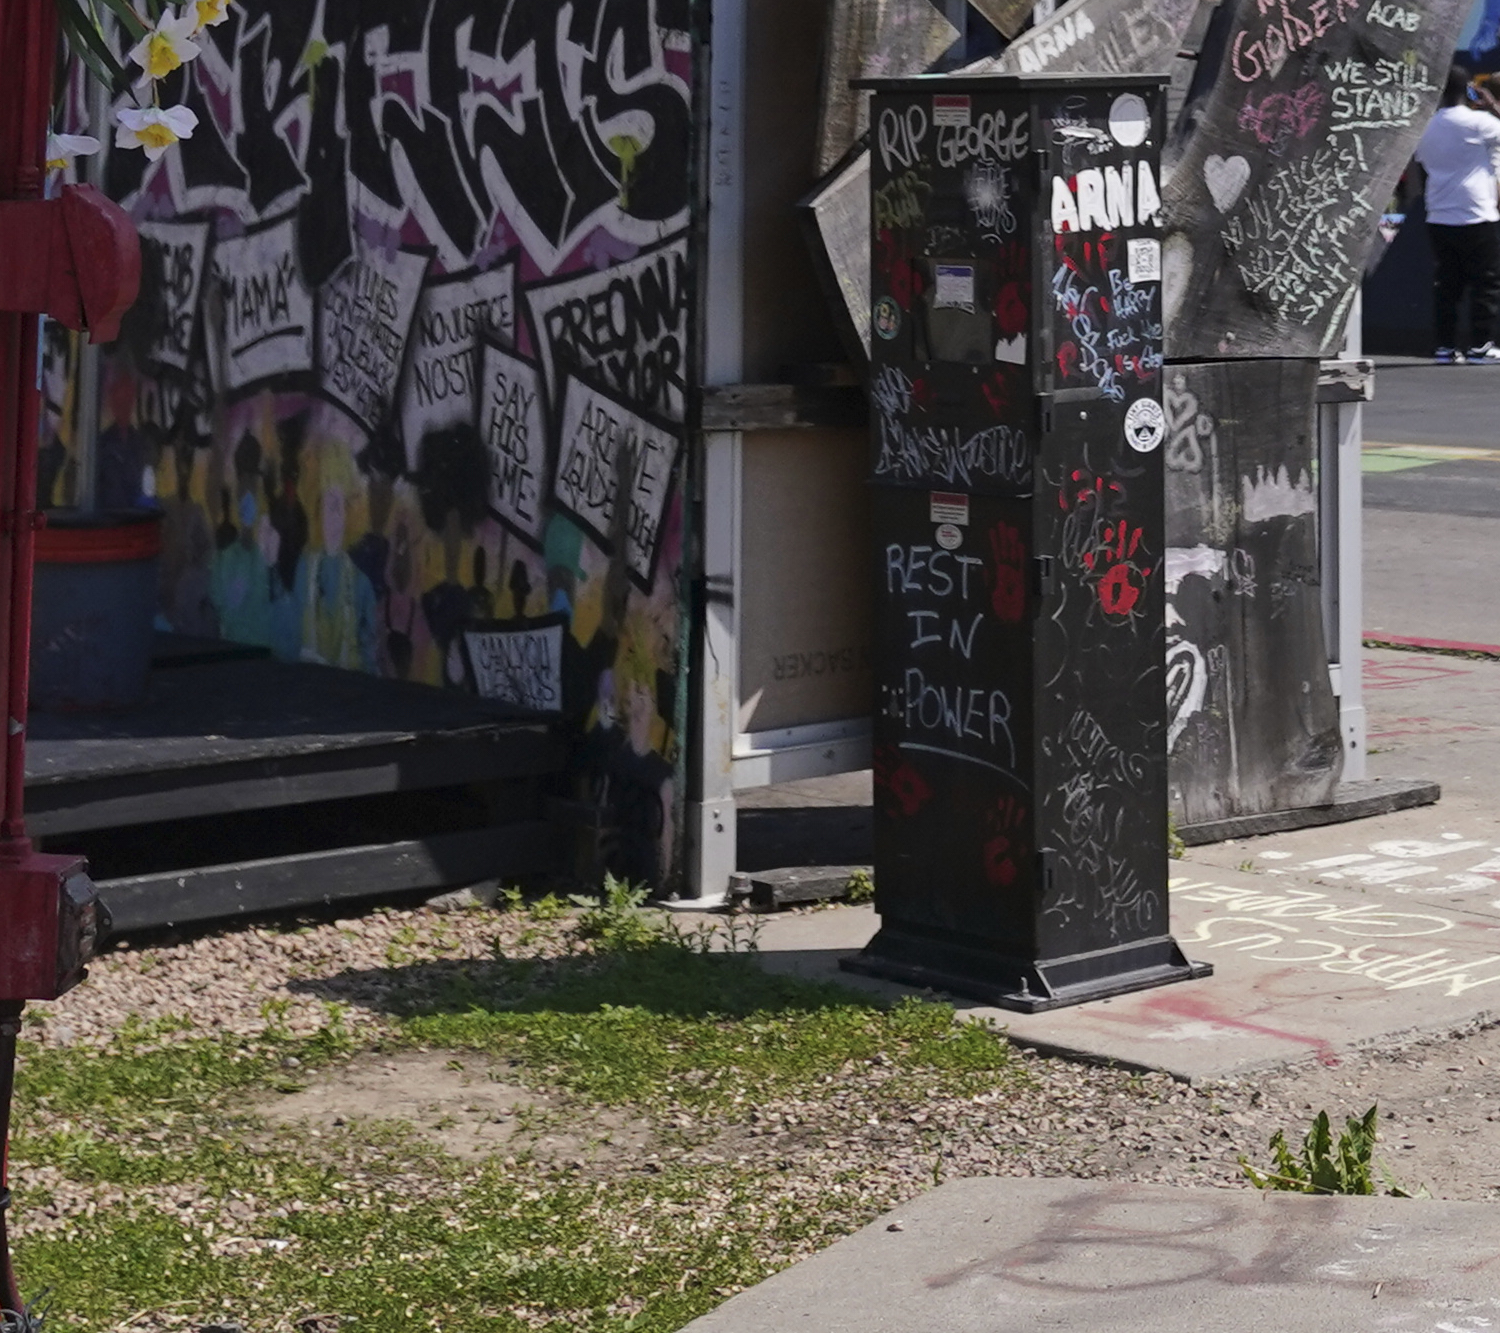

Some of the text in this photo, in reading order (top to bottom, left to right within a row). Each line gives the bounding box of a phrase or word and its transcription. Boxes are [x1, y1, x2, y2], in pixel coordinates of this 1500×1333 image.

[1017, 9, 1097, 74] ARNA
[1366, 0, 1423, 33] ACAB
[1323, 59, 1366, 84] WE
[1331, 87, 1421, 120] STAND
[878, 104, 928, 172] RIP
[936, 108, 1031, 169] GEORGE
[1050, 159, 1164, 235] ARNA
[493, 372, 536, 426] SAY
[487, 405, 529, 466] HIS
[885, 542, 985, 601] REST
[907, 608, 985, 660] IN
[903, 666, 1016, 770] POWER
